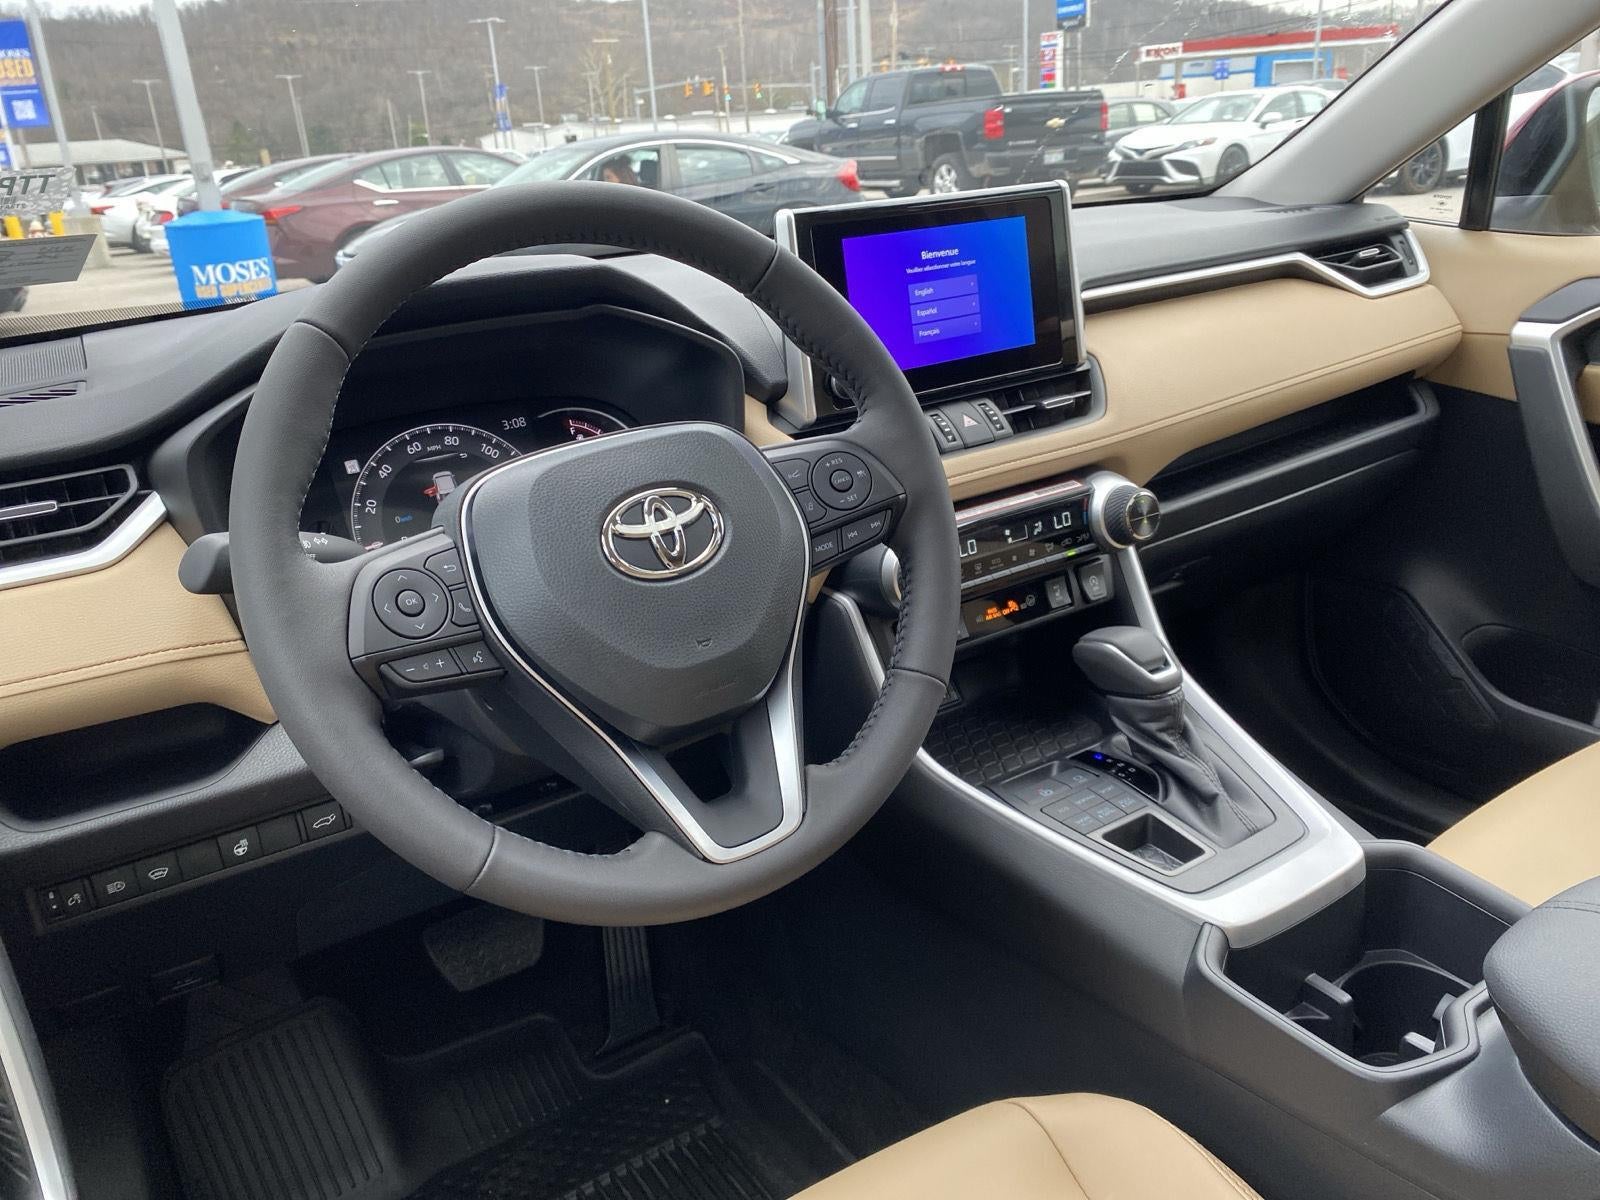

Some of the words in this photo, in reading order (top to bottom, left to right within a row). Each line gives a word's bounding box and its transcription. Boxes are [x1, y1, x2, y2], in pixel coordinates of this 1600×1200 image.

[921, 248, 959, 260] Bienvenue
[190, 257, 271, 285] MOSES
[915, 287, 934, 297] English
[501, 416, 527, 431] 3:08
[569, 427, 576, 436] F
[444, 435, 460, 446] 80
[406, 441, 422, 455] 60
[426, 444, 442, 453] MPH
[480, 443, 500, 459] 100
[378, 463, 393, 479] 40
[365, 499, 377, 515] 20
[1053, 511, 1072, 530] LO
[815, 541, 834, 553] MODE
[405, 598, 418, 607] OK
